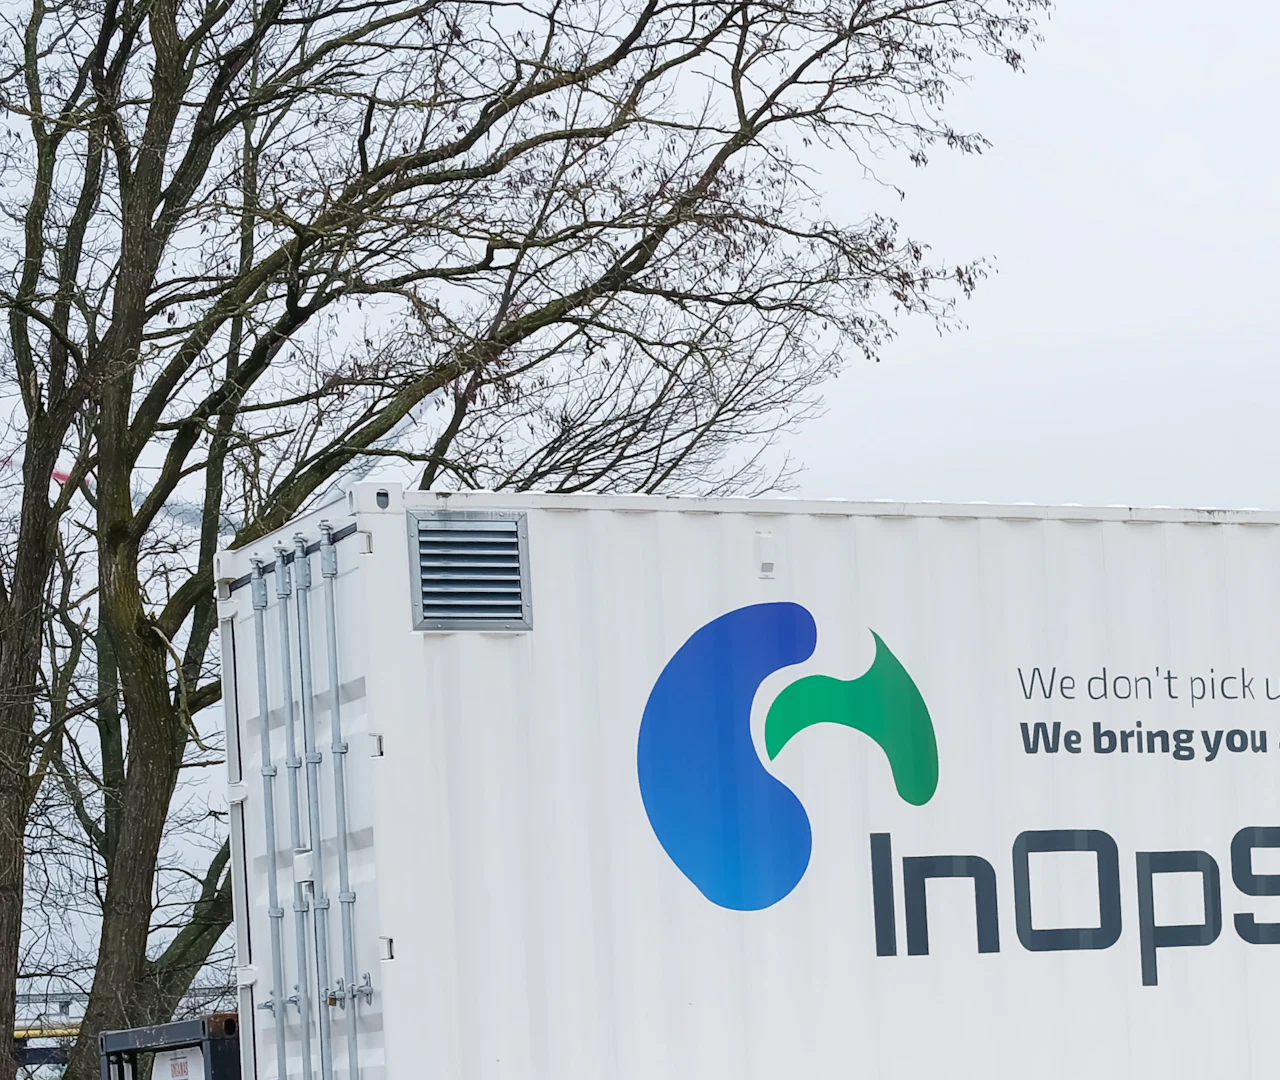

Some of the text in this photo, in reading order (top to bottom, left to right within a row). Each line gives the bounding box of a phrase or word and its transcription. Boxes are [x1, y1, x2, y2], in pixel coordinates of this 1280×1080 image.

[1018, 667, 1075, 700] We
[1088, 667, 1178, 700] don't
[1191, 667, 1255, 707] pick
[1020, 721, 1082, 754] We
[1093, 721, 1196, 761] bring
[1200, 728, 1268, 762] you
